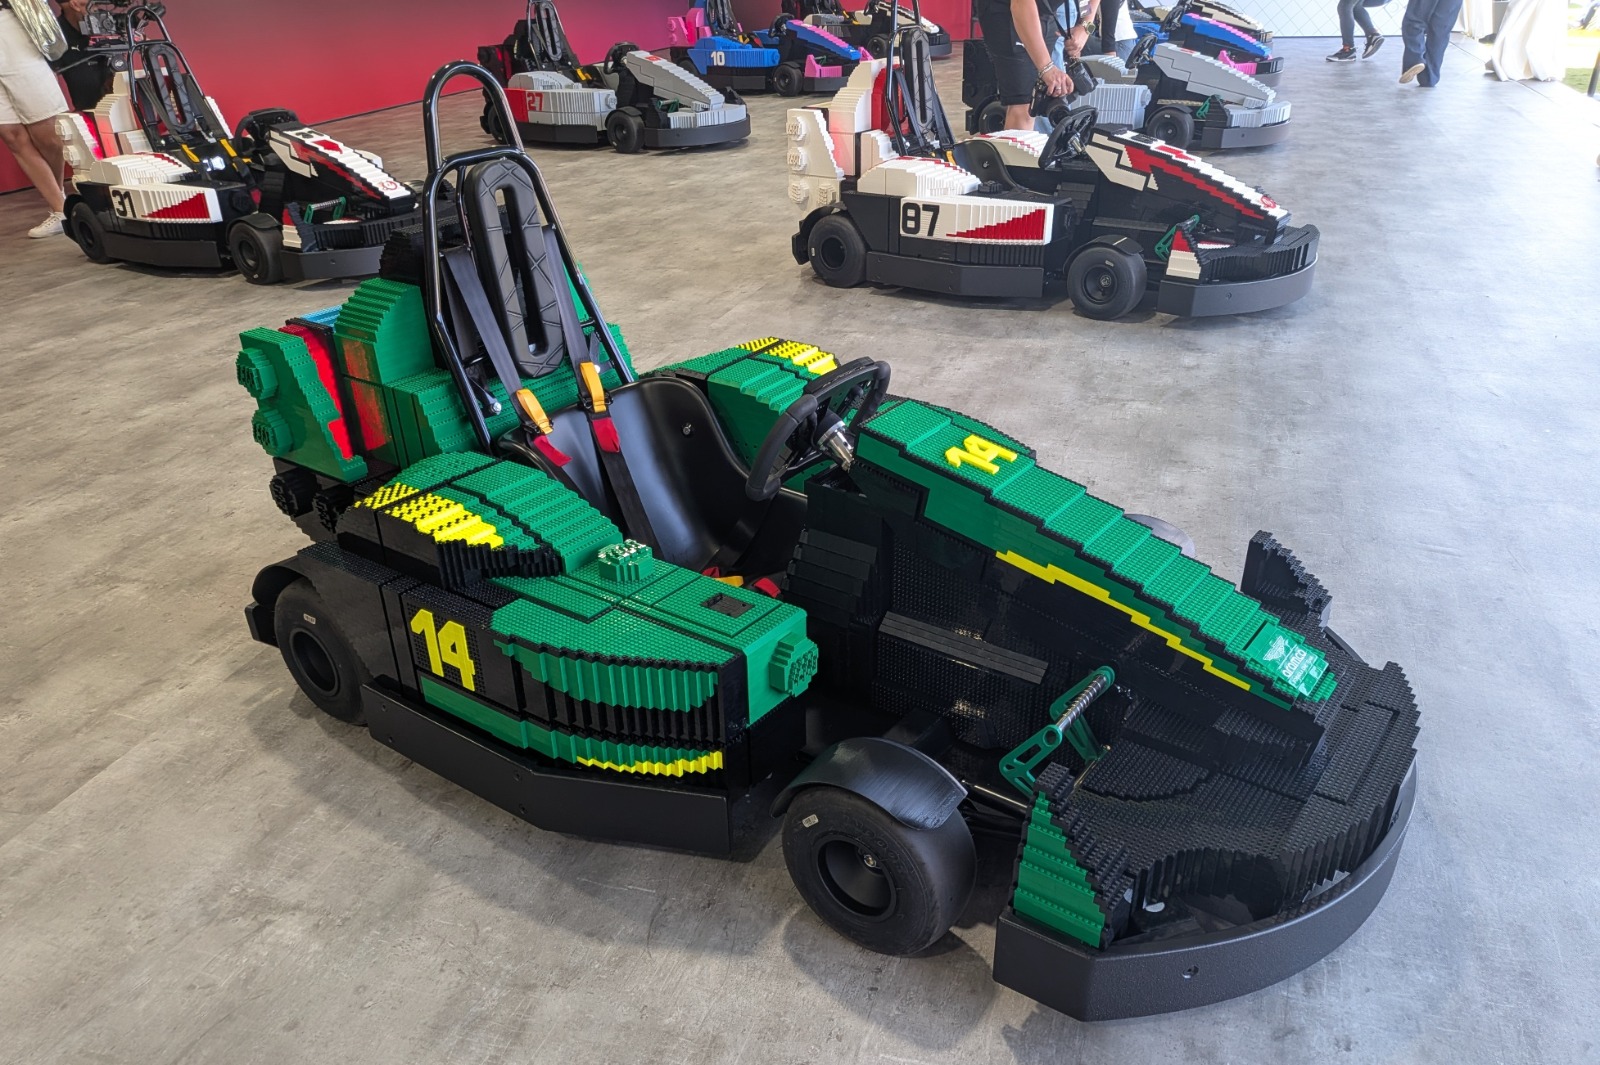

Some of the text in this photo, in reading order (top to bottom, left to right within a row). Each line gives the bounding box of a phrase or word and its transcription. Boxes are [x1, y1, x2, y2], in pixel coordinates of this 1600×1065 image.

[711, 51, 725, 66] 10
[527, 92, 543, 111] 27
[111, 189, 137, 218] 31
[902, 202, 940, 237] 87
[945, 434, 1018, 476] 14
[410, 608, 476, 692] 14
[1282, 649, 1307, 678] aramco
